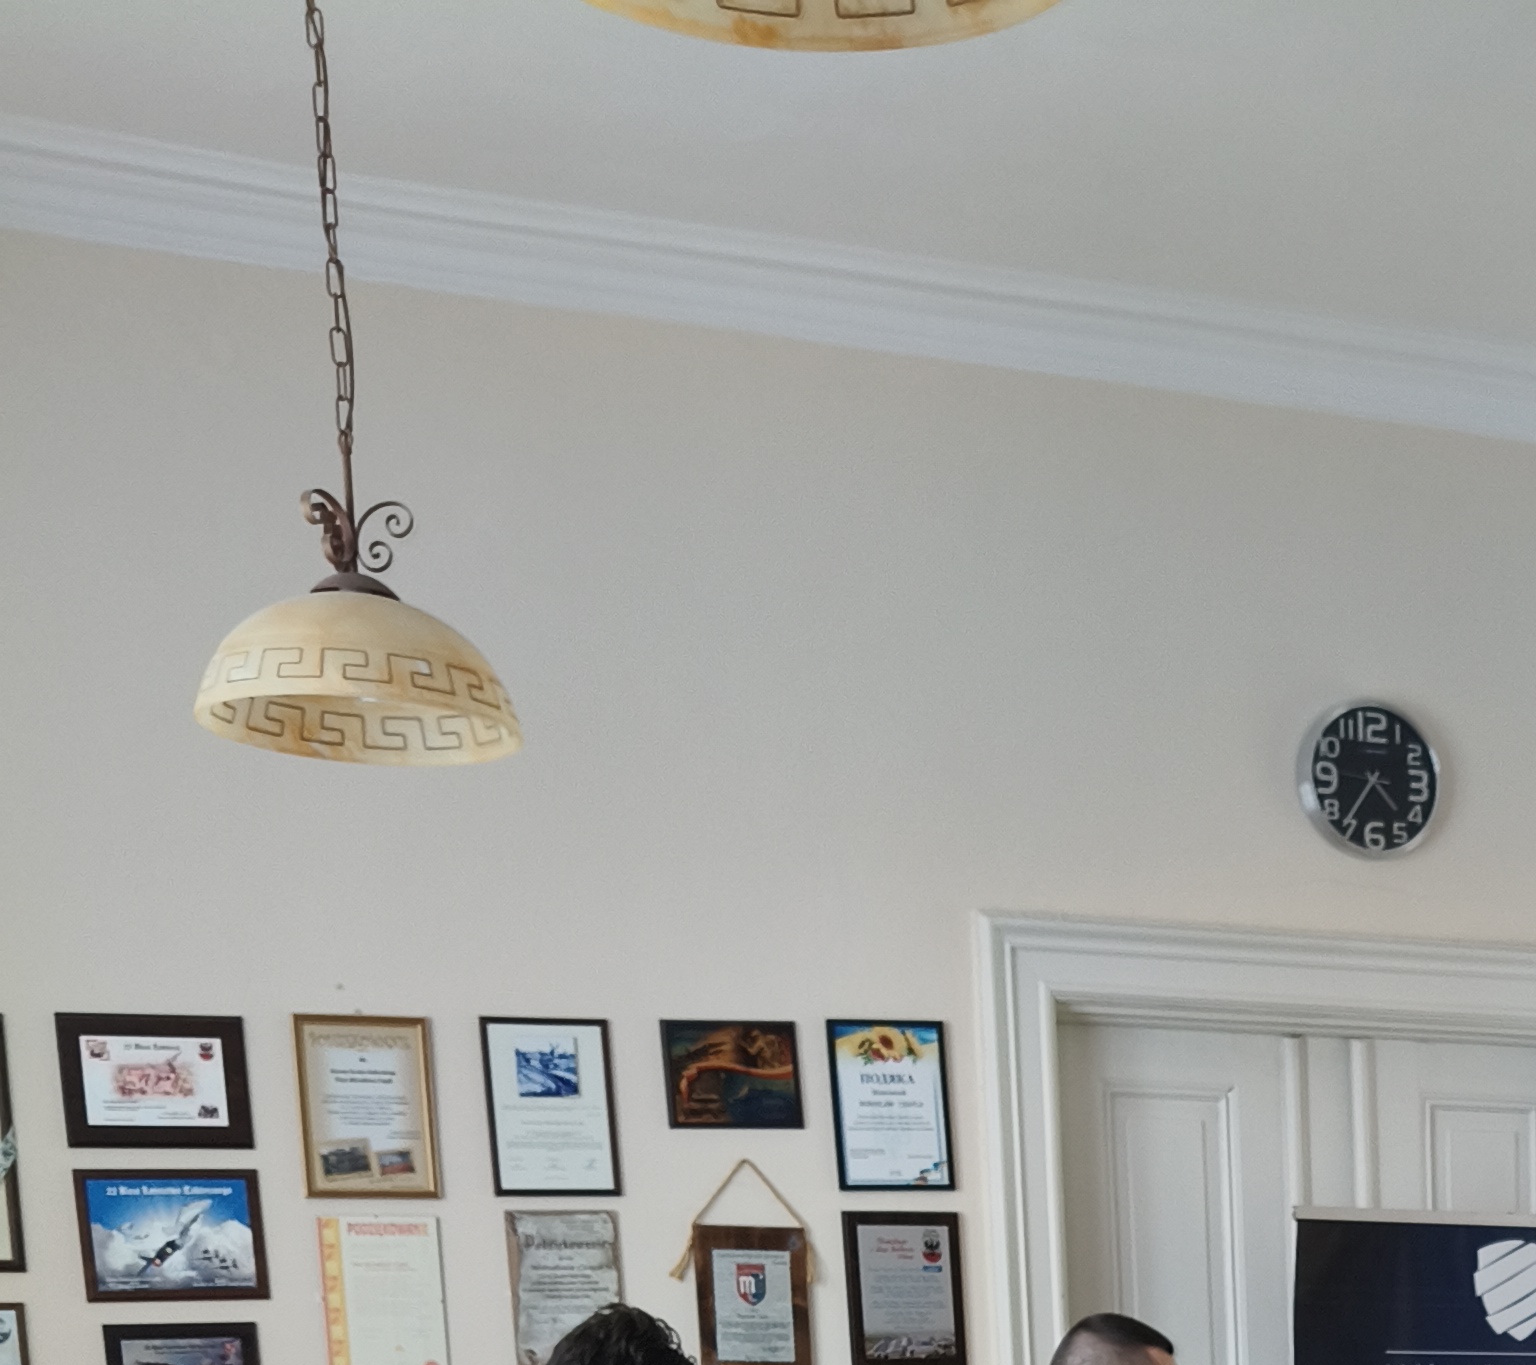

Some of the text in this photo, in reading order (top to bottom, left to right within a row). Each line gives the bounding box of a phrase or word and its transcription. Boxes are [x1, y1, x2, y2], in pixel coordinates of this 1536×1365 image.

[1357, 711, 1389, 744] 12
[1395, 723, 1401, 745] 1
[1407, 744, 1421, 766] 2
[1316, 761, 1338, 795] 9
[1408, 769, 1429, 803] 3
[1323, 798, 1340, 820] 8
[1407, 804, 1422, 823] 4
[1345, 818, 1358, 840] 7
[1363, 821, 1385, 850] 6
[1393, 822, 1408, 843] 5
